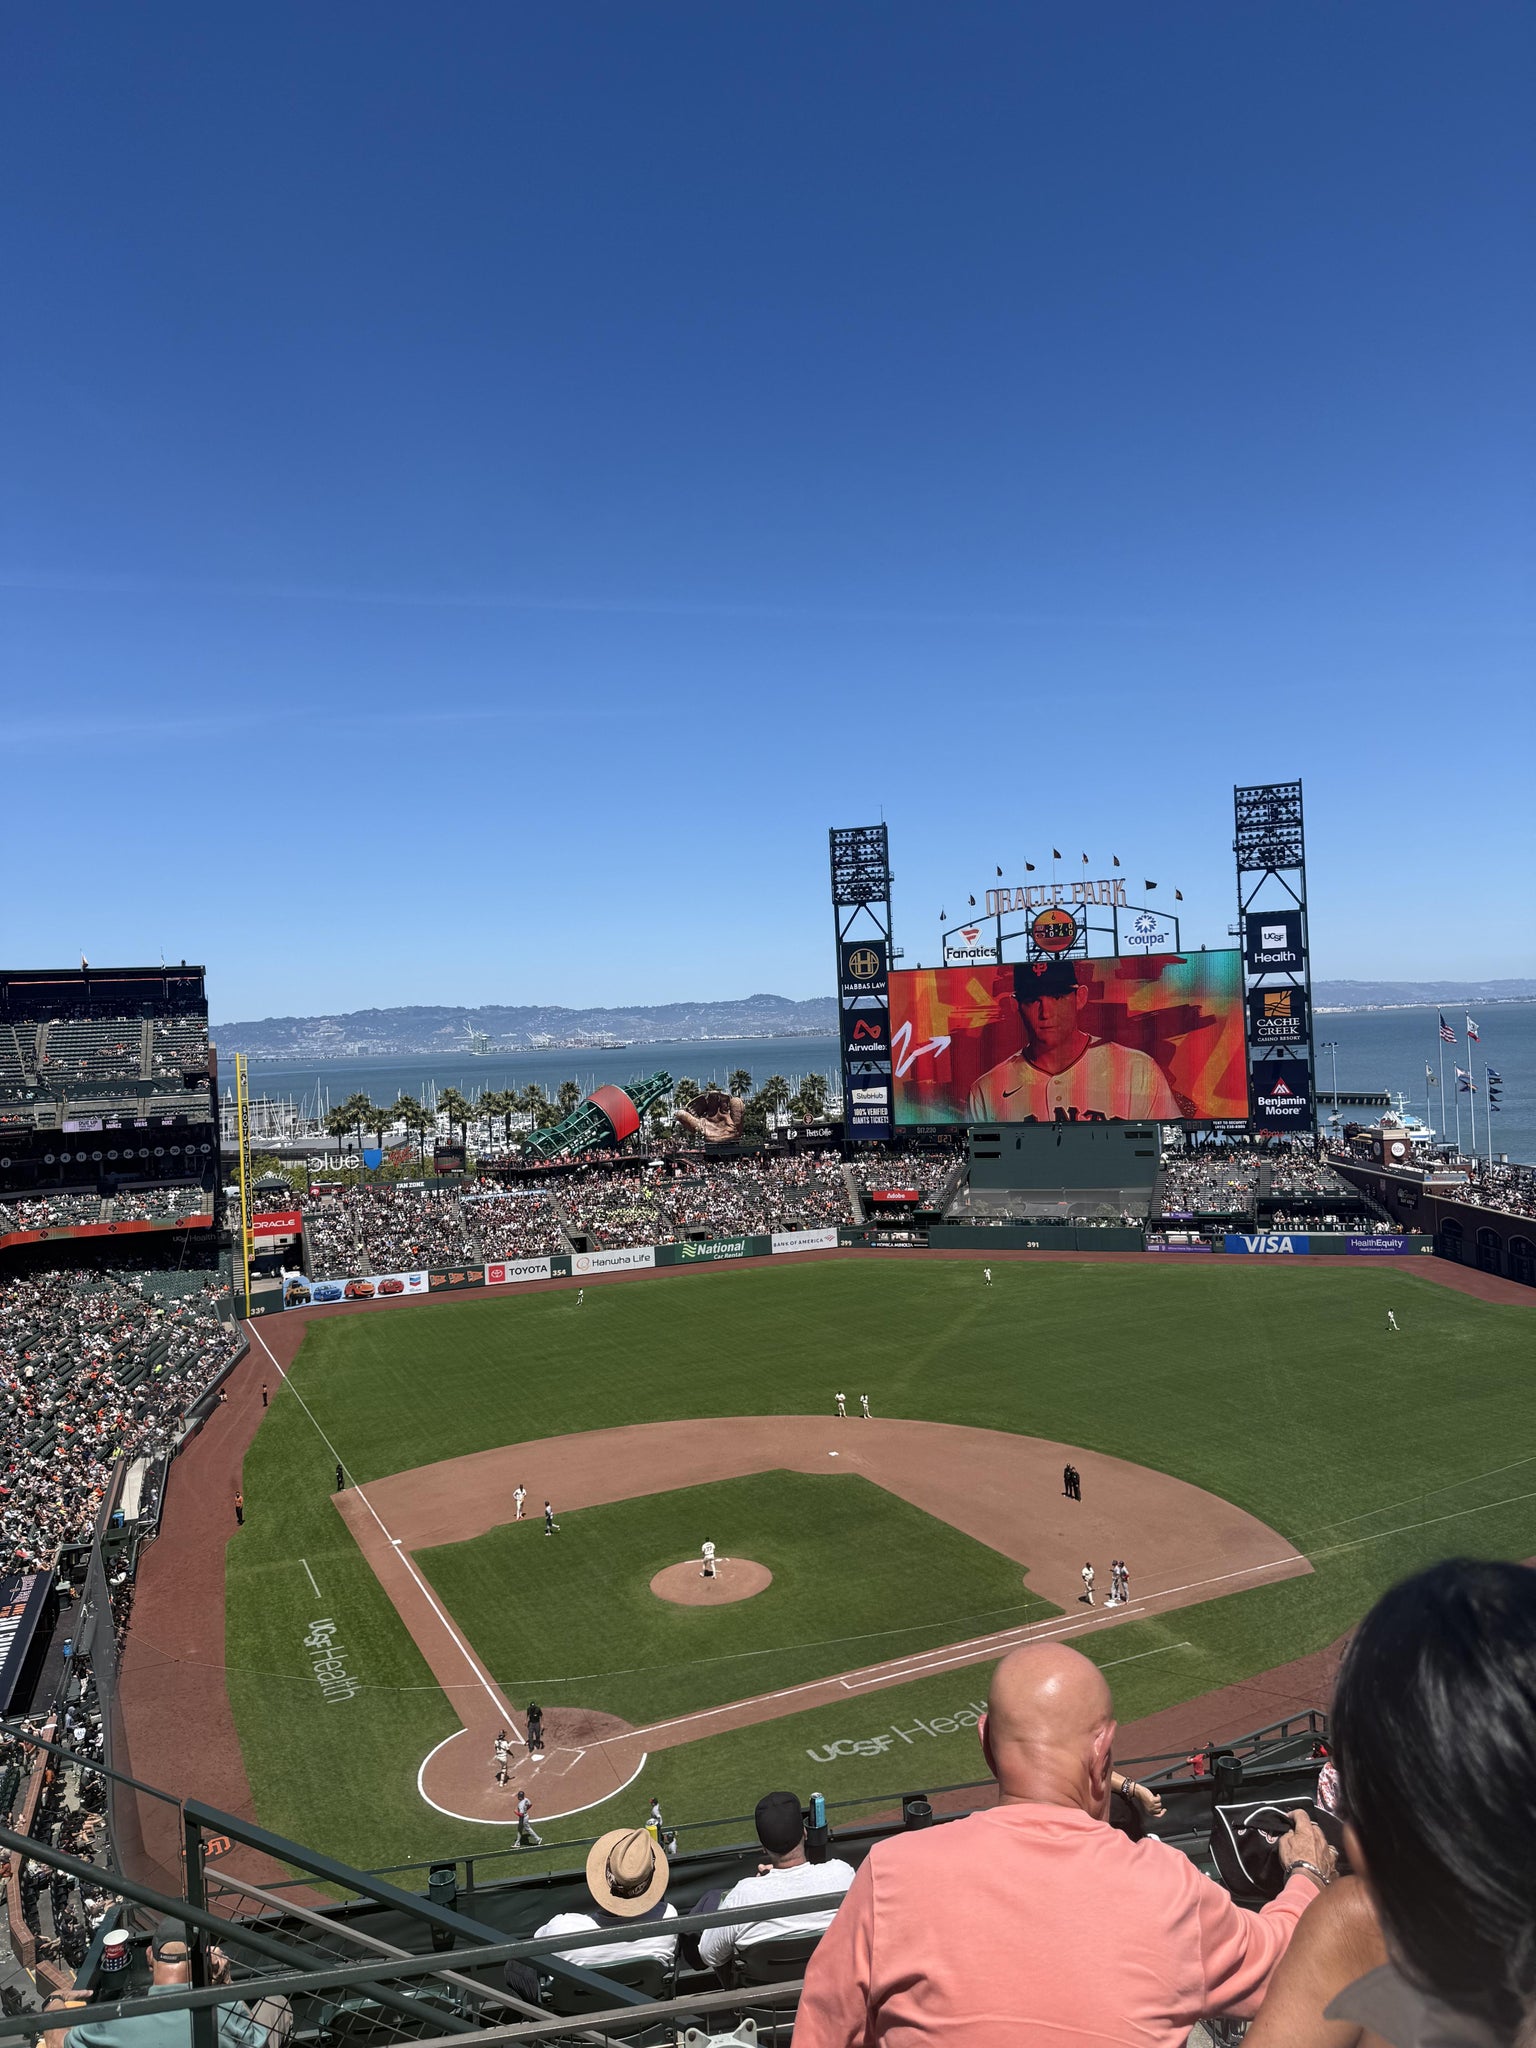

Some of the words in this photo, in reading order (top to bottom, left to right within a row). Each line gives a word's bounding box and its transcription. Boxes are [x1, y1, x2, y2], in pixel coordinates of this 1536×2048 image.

[986, 884, 1064, 917] ORACLE
[1071, 878, 1128, 907] PARK
[1128, 934, 1165, 946] coupa
[1264, 933, 1285, 941] UCSF
[946, 946, 997, 960] Fanatics
[1254, 951, 1296, 963] Health
[1257, 1018, 1301, 1027] CACHE
[1258, 1026, 1299, 1036] CREEK
[1258, 1096, 1306, 1107] Benjamin
[1265, 1106, 1300, 1115] Moore
[253, 1219, 295, 1229] ORACLE
[798, 1238, 824, 1246] AMERICA
[1240, 1235, 1294, 1253] VISA
[1351, 1239, 1404, 1248] HealthEquity
[697, 1240, 745, 1256] National
[592, 1256, 630, 1268] Hanwha
[632, 1254, 651, 1263] Life
[509, 1265, 548, 1276] TOYOTA
[250, 1306, 265, 1315] 339
[303, 1618, 337, 1648] UCSF
[309, 1646, 362, 1704] Health
[806, 1734, 895, 1762] UCSF
[890, 1700, 988, 1744] Heal
